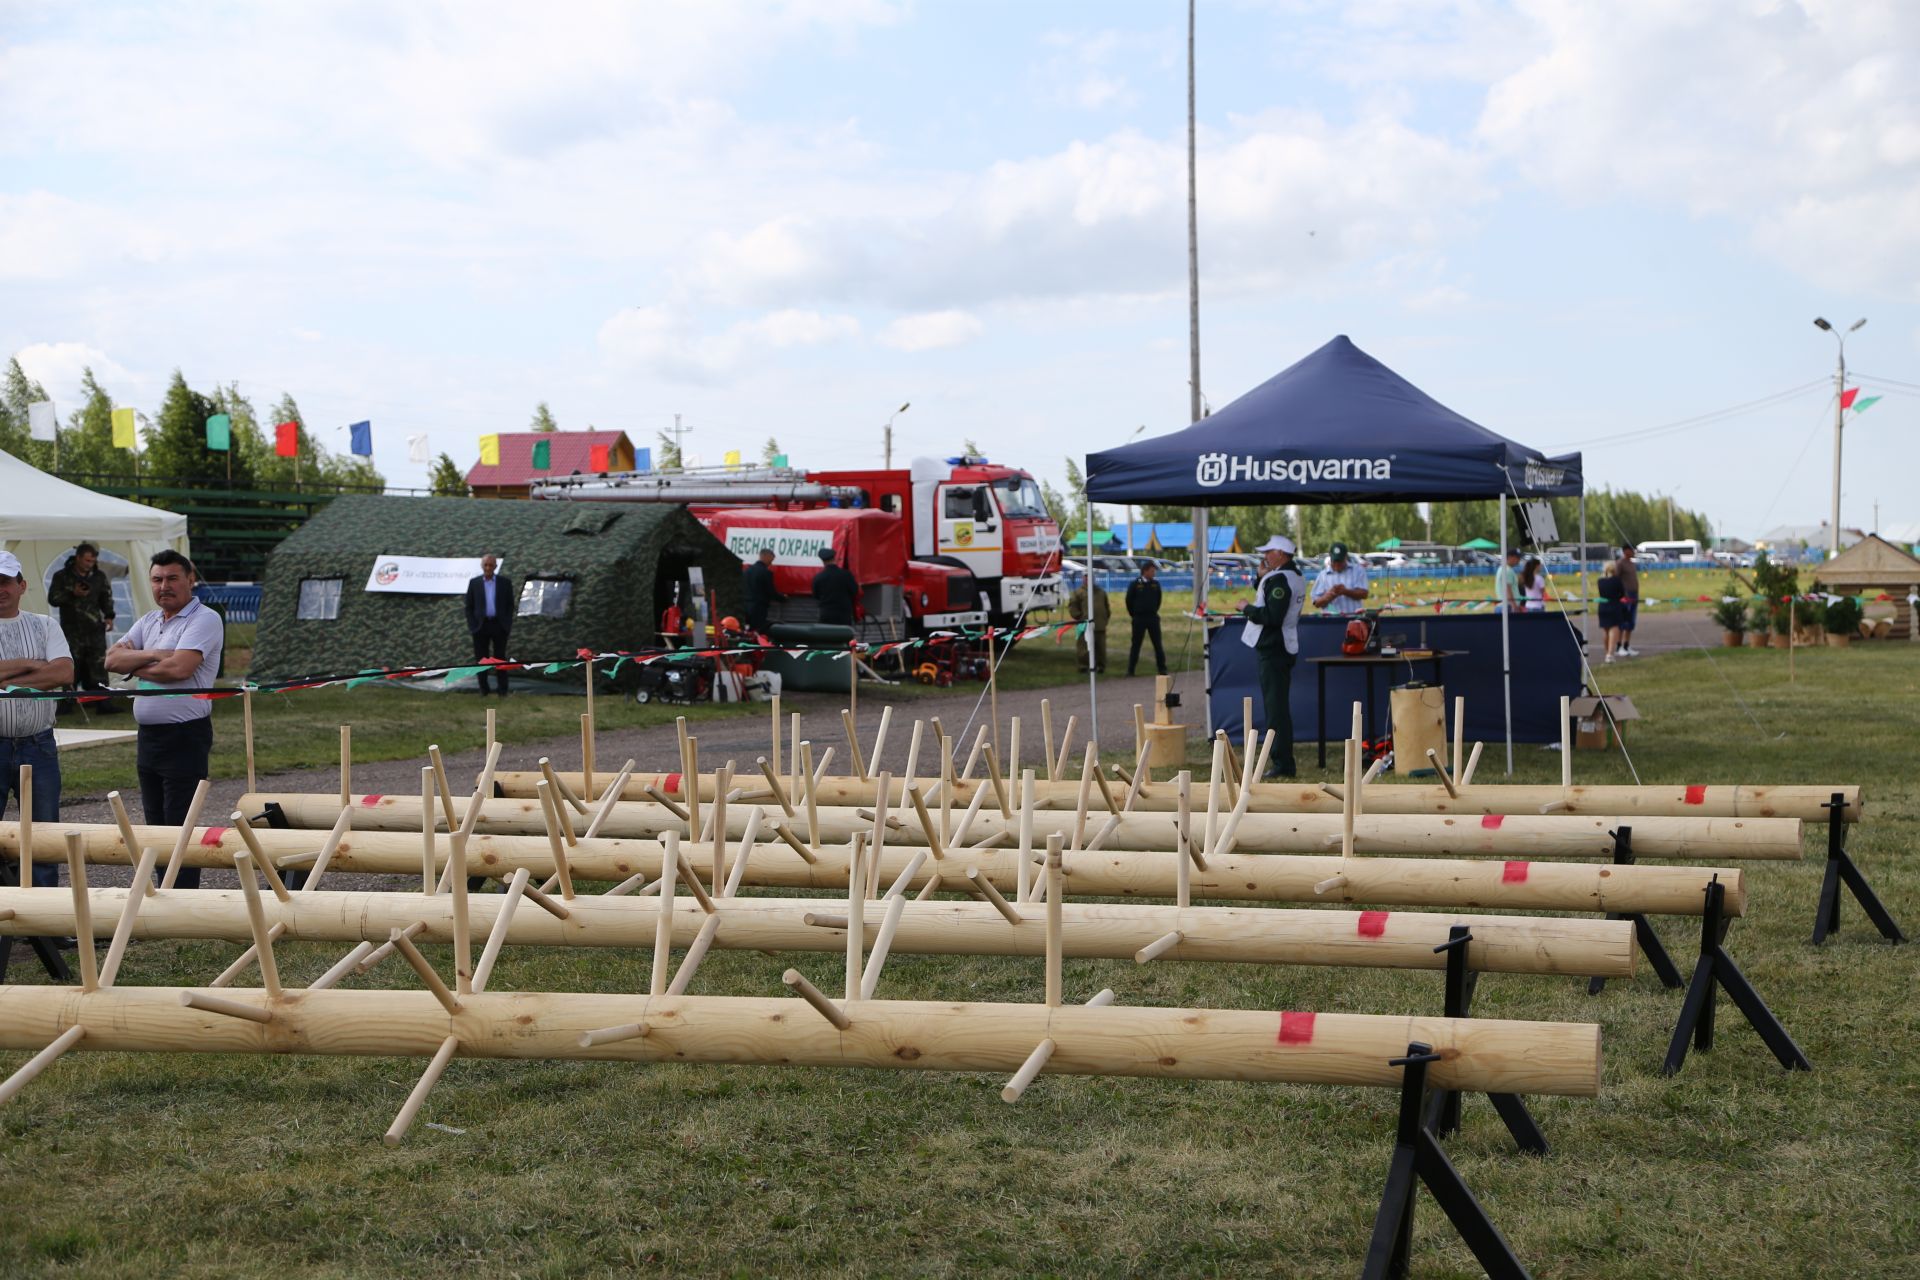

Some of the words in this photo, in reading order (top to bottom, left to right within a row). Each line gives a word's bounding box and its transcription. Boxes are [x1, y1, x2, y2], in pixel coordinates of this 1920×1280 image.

[1229, 455, 1391, 485] Husqvarna
[730, 535, 776, 555] ЛЕСНАЯ
[778, 537, 826, 558] ОХРАНА
